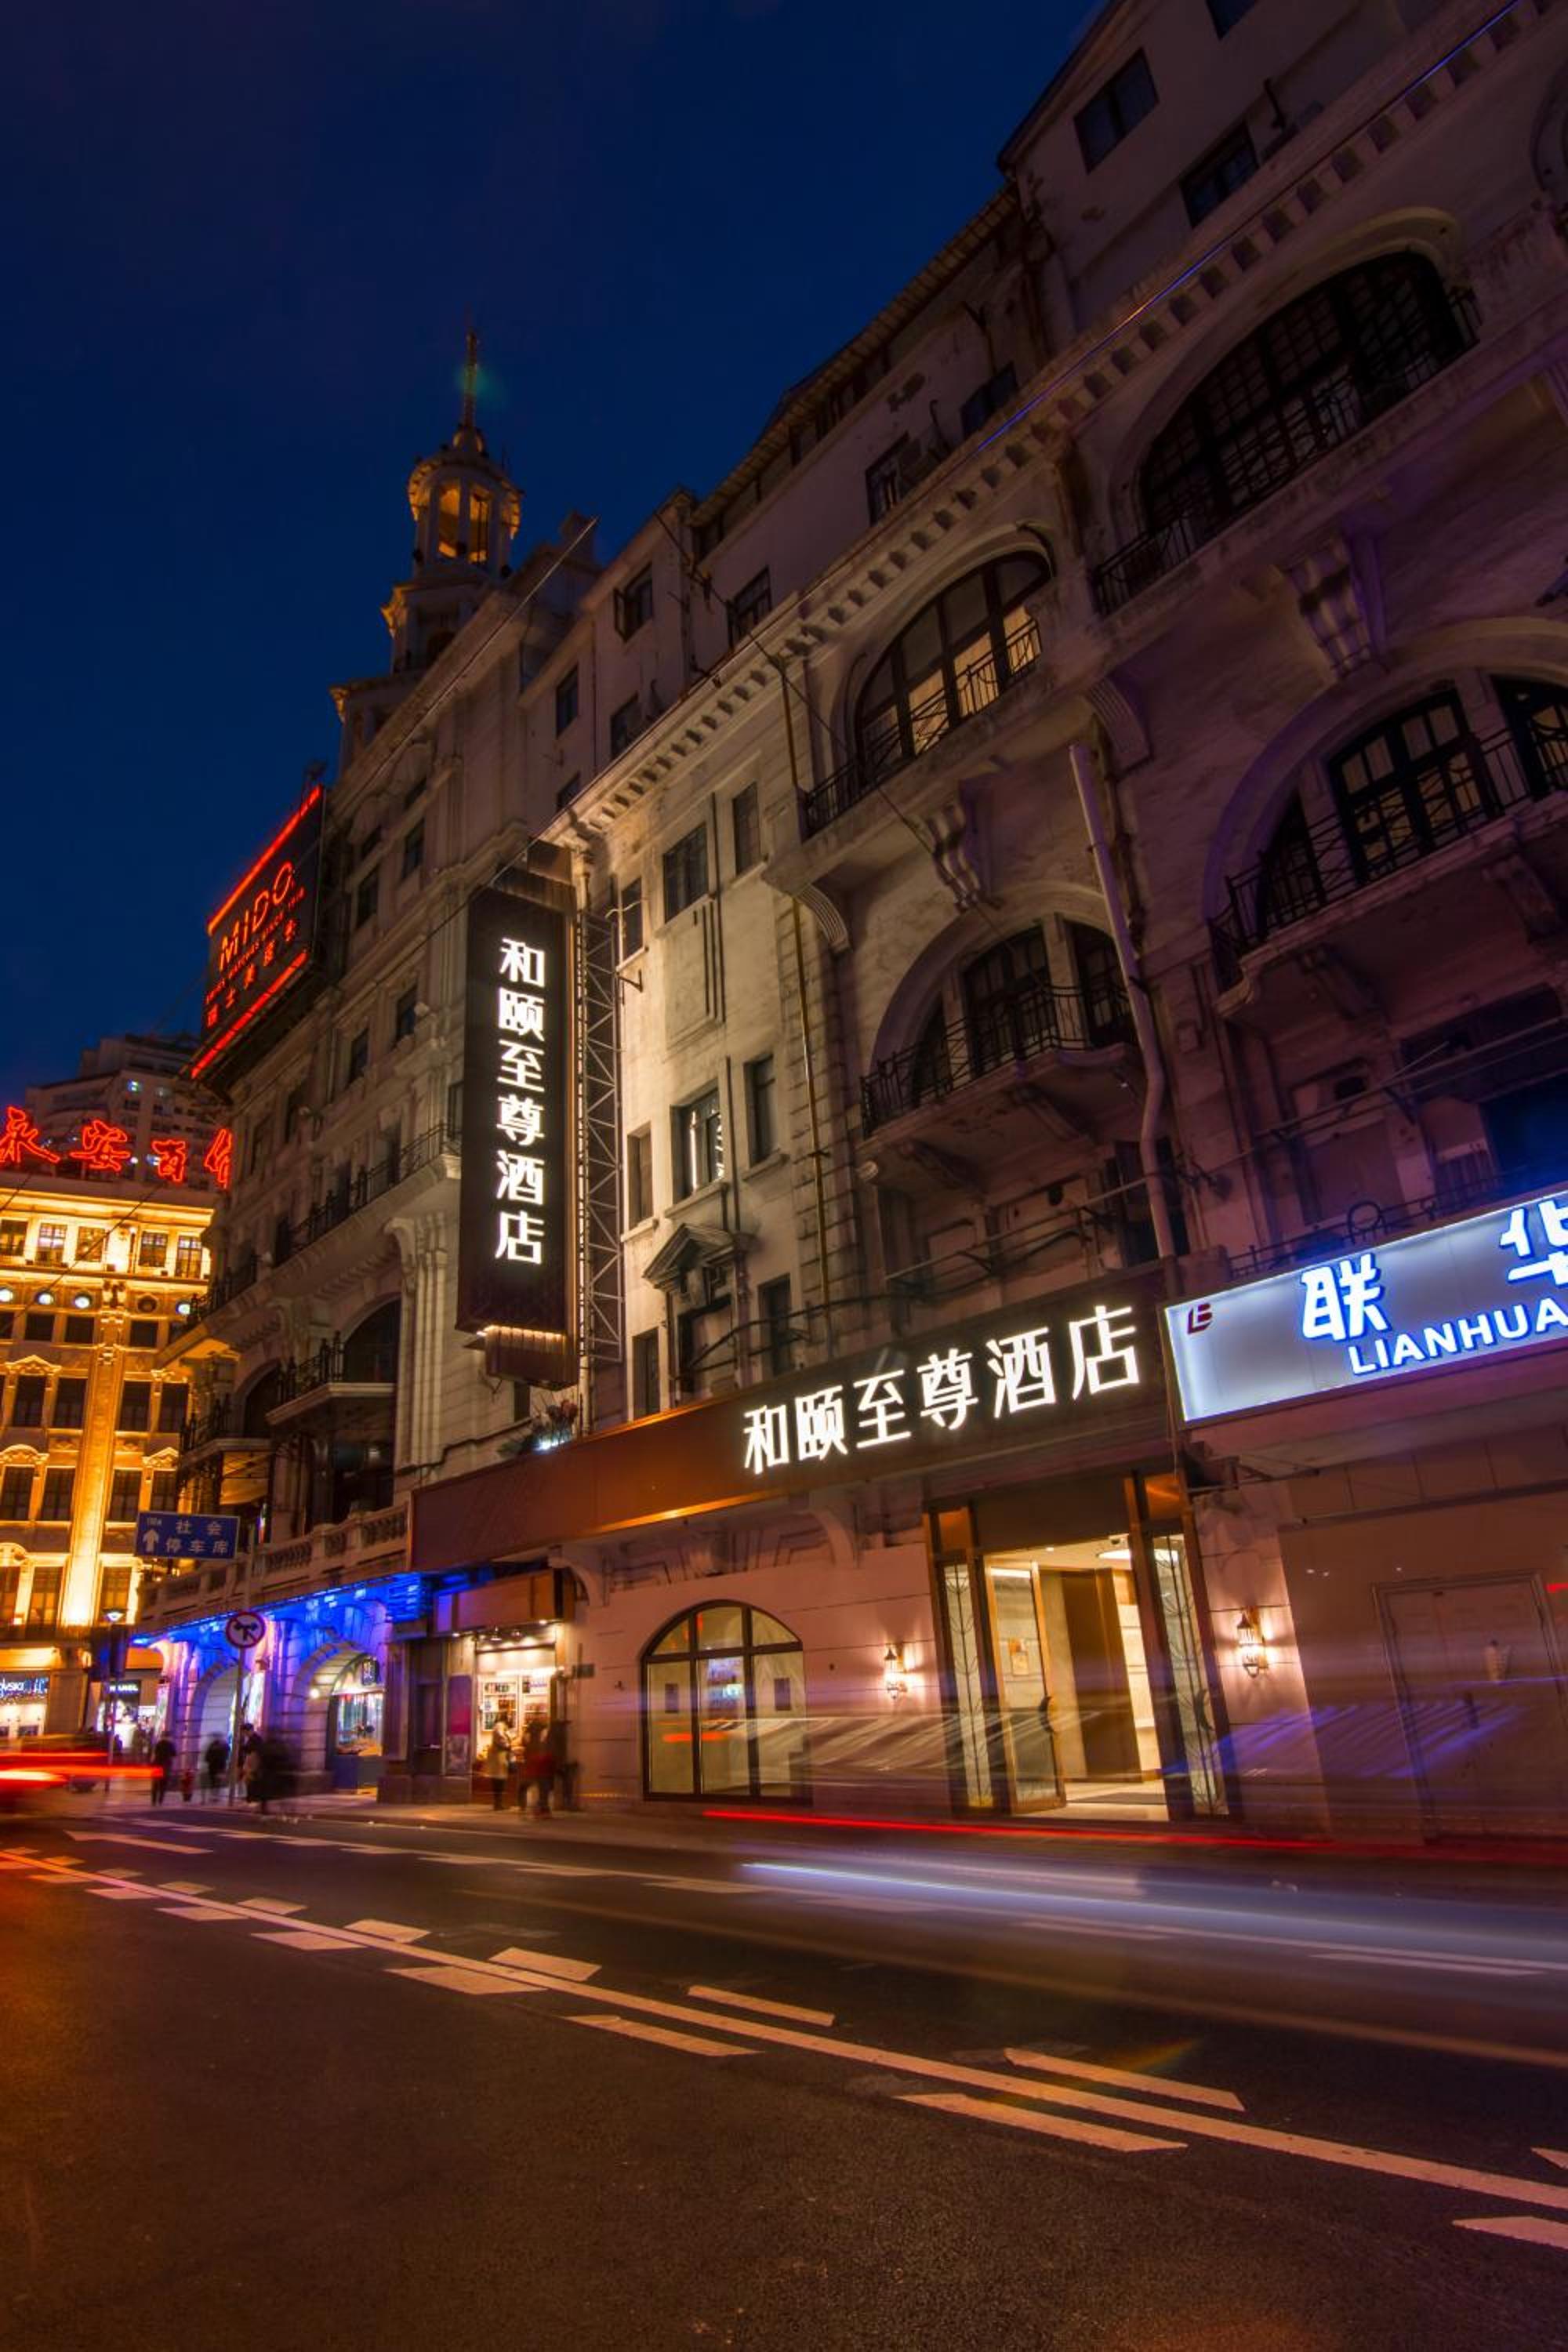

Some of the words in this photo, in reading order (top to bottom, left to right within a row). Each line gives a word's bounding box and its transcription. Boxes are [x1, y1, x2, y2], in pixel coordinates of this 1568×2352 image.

[218, 860, 293, 972] MIDO
[495, 938, 546, 1265] 和颐至尊酒店
[743, 1305, 1140, 1475] 和颐至尊酒店
[1348, 1297, 1568, 1375] LIANHUA
